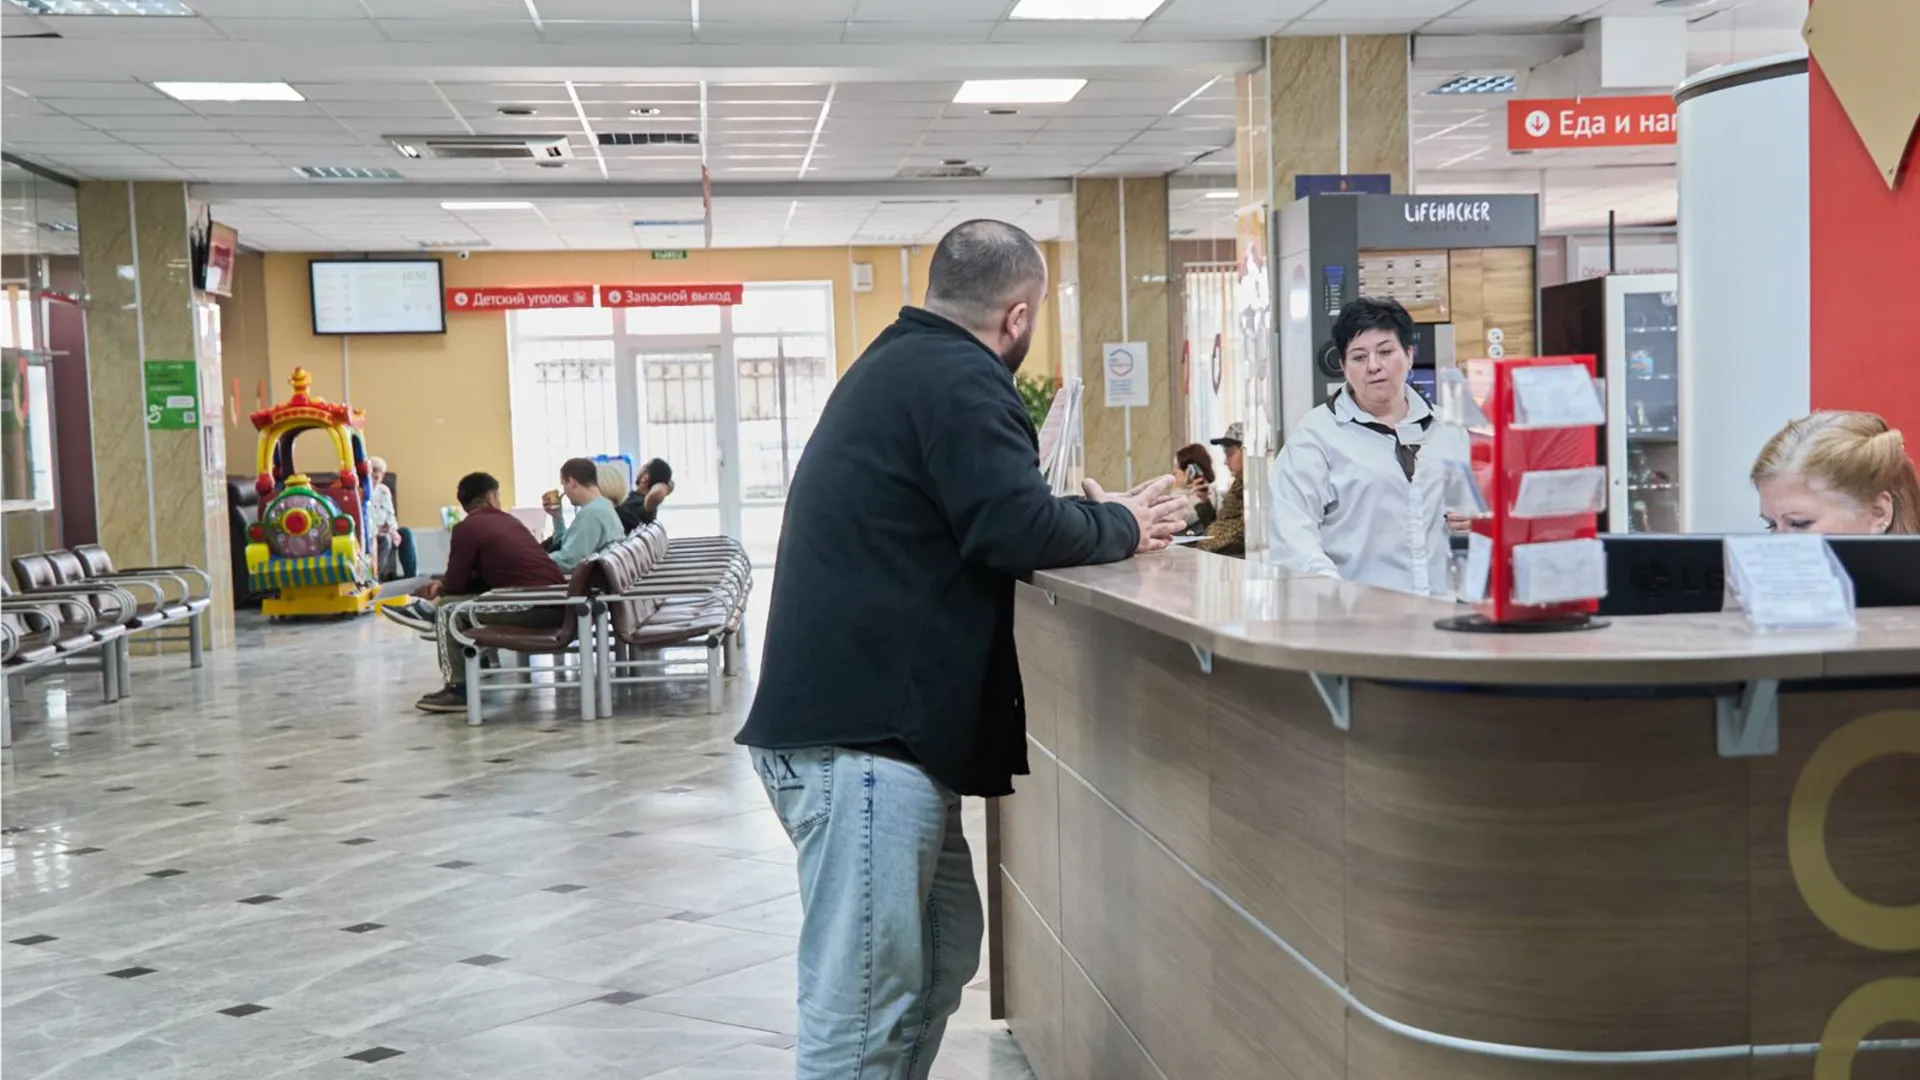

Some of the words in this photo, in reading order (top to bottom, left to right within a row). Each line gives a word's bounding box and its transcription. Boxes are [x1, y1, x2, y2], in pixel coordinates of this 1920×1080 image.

[1559, 110, 1606, 139] Еда
[1615, 115, 1631, 134] и
[472, 292, 525, 308] Детский
[528, 294, 570, 307] уголок
[625, 289, 688, 303] Запасной
[691, 291, 732, 303] выход
